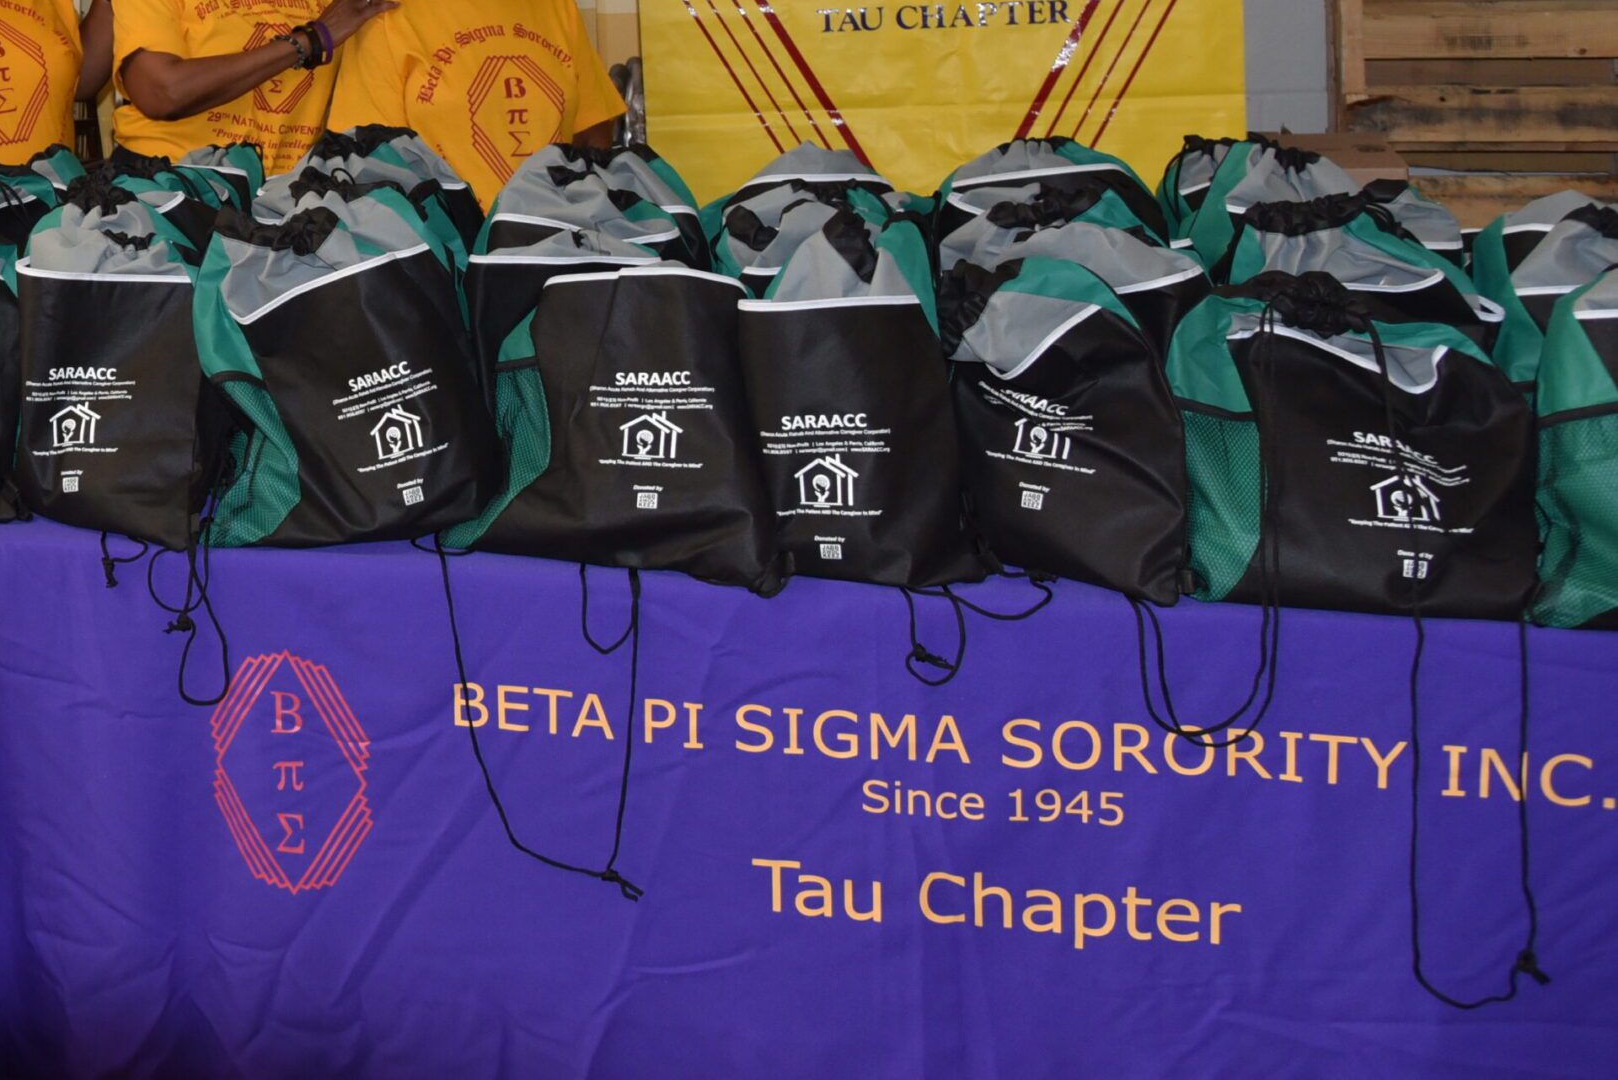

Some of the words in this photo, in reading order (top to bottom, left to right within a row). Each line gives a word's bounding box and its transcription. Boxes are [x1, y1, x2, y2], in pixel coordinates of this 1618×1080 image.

[816, 5, 883, 34] TAU
[895, 0, 1072, 30] CHAPTER
[416, 65, 443, 106] Beta
[432, 43, 456, 66] Pi
[454, 24, 506, 48] Sigma
[49, 366, 117, 380] SARAACC
[348, 361, 411, 392] SARAACC
[615, 371, 691, 386] SARAACC
[781, 413, 867, 431] SARAACC
[452, 682, 614, 741] BETA
[643, 698, 704, 750] PI
[734, 704, 971, 765] SIGMA
[1001, 718, 1407, 790] SORORITY
[1441, 744, 1617, 810] INC.
[273, 761, 304, 791] π
[861, 779, 985, 821] Since
[1006, 787, 1125, 827] 1945
[277, 812, 305, 854] Σ
[751, 858, 882, 923] Tau
[919, 871, 1242, 950] Chapter
